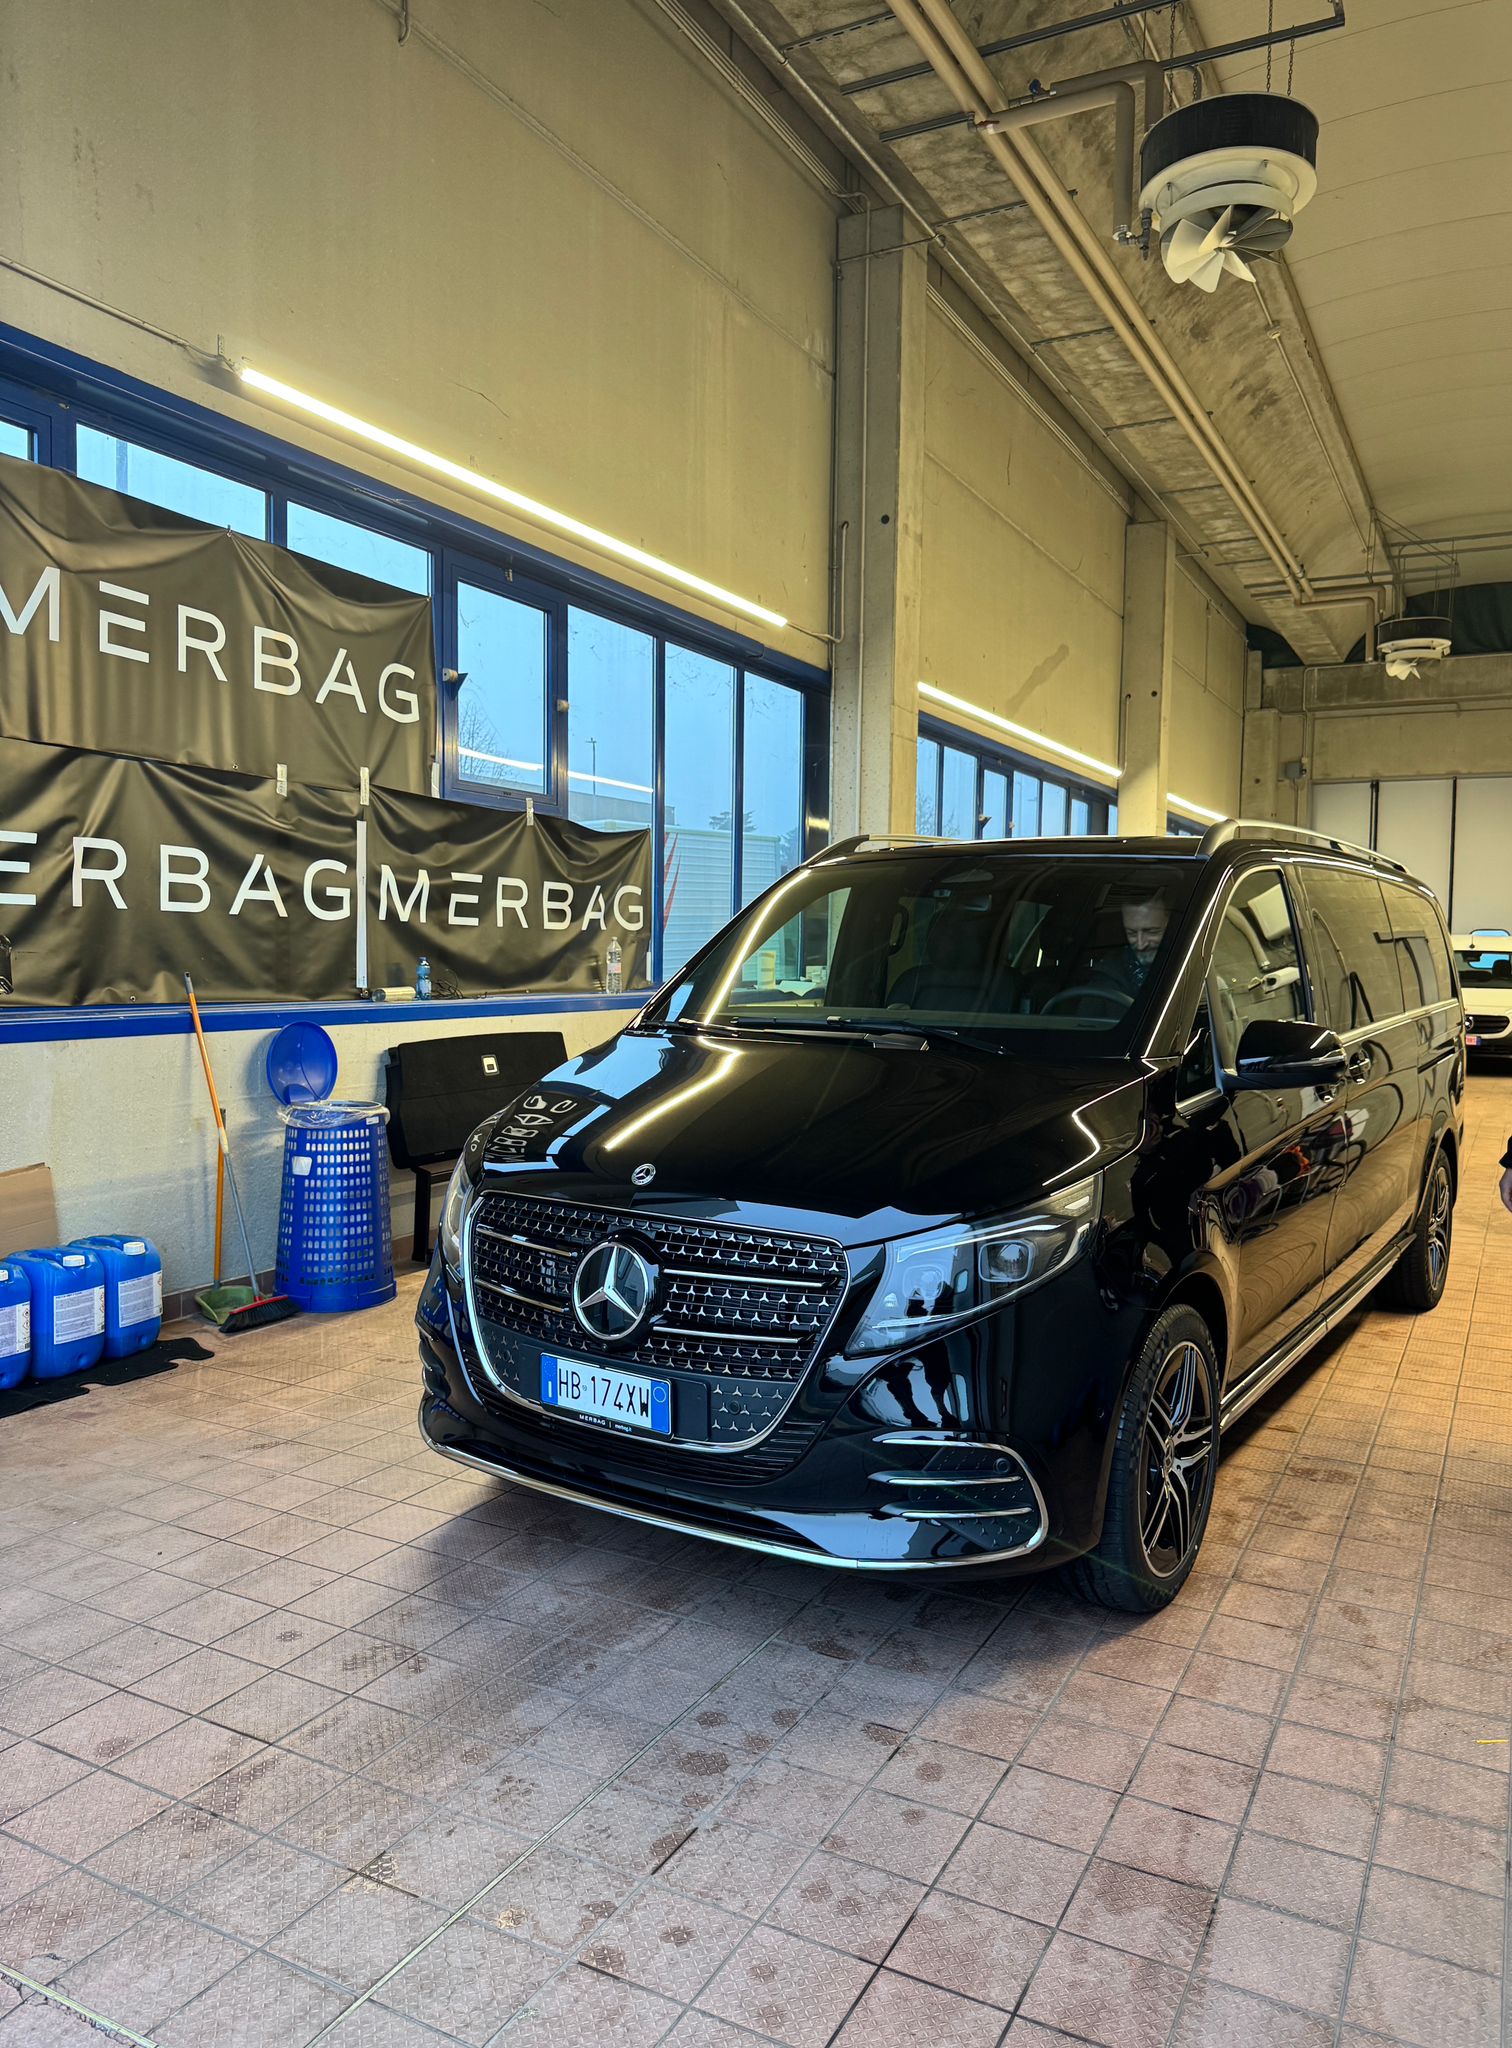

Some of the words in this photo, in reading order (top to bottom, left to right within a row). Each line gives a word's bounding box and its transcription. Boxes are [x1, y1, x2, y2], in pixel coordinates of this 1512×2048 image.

[0, 566, 419, 724] MERBAG
[378, 864, 644, 931] MERBAG
[558, 1368, 581, 1400] HB
[591, 1375, 650, 1418] 174XW
[579, 1414, 606, 1426] MERBAG
